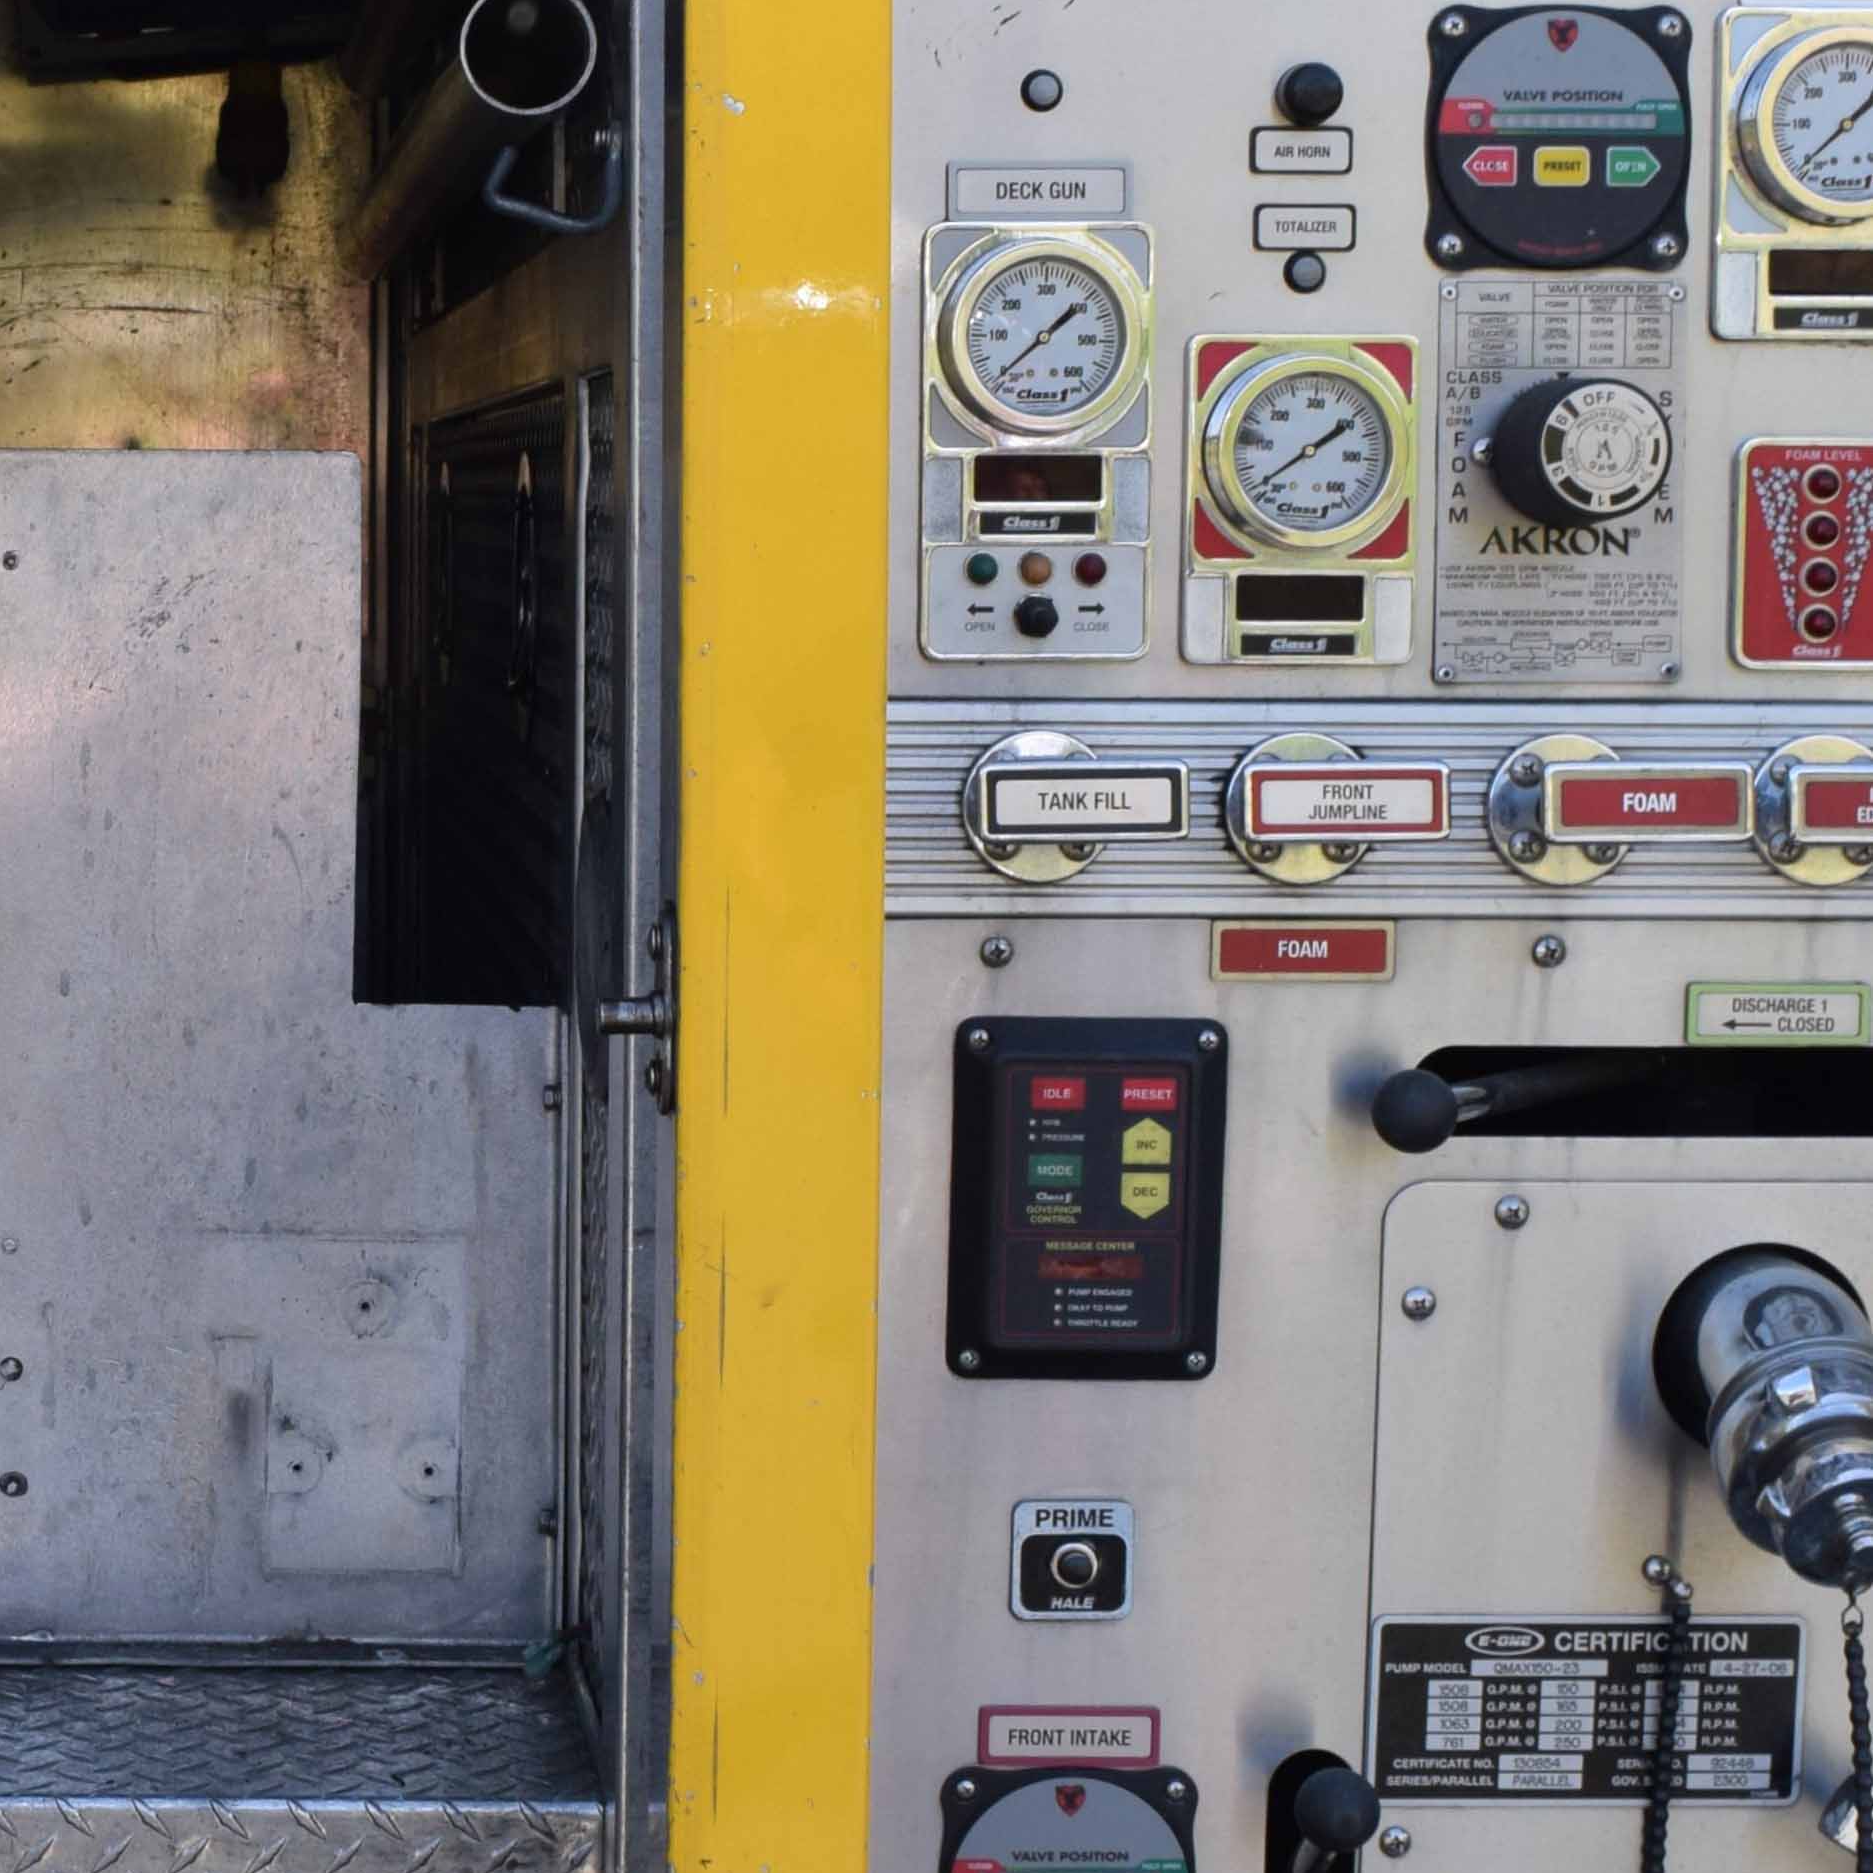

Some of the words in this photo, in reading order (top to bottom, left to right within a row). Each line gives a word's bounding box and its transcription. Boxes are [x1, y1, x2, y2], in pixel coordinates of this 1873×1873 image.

[1838, 71, 1856, 82] 300
[1504, 90, 1546, 101] VALVE
[1552, 90, 1623, 101] POSITION
[1804, 87, 1822, 98] 200
[1793, 119, 1811, 129] 100
[1275, 146, 1294, 158] AIR
[1297, 146, 1331, 158] HORN
[1473, 161, 1509, 172] CLOSE
[1543, 161, 1582, 171] PRESET
[1615, 161, 1647, 172] OPEN
[996, 182, 1042, 199] DECK
[1049, 182, 1086, 199] GUN
[1275, 221, 1337, 233] TOTALIZER
[1037, 284, 1055, 295] 300
[1547, 285, 1579, 293] VALVE
[1583, 285, 1633, 294] POSITION
[1478, 293, 1510, 302] VALVE
[1002, 300, 1021, 311] 200
[989, 330, 1008, 340] 100
[1078, 335, 1097, 346] 500
[1064, 366, 1083, 377] 600
[1446, 371, 1502, 384] CLASS
[1446, 387, 1481, 401] A/B
[1583, 391, 1615, 406] OFF
[1306, 398, 1325, 410] 300
[1270, 410, 1289, 422] 200
[1342, 450, 1361, 462] 500
[1785, 449, 1821, 461] FOAM
[1824, 449, 1862, 462] LEVEL
[1326, 482, 1345, 493] 600
[1479, 527, 1630, 555] AKRON
[965, 622, 995, 631] OPEN
[1074, 622, 1109, 631] CLOSE
[1322, 784, 1374, 800] FRONT
[1038, 792, 1087, 811] TANK
[1094, 792, 1131, 811] FILL
[1622, 792, 1677, 813] FOAM
[1307, 804, 1388, 821] JUMPLINE
[1277, 940, 1328, 959] FOAM
[1732, 998, 1817, 1013] DISCHARGE
[1821, 998, 1828, 1013] 1
[1777, 1017, 1835, 1032] CLOSED
[1043, 1088, 1071, 1099] IDLE
[1124, 1088, 1173, 1100] PRESET
[1136, 1140, 1158, 1150] INC
[1037, 1165, 1073, 1176] MODE
[1133, 1186, 1158, 1197] DEC
[1026, 1206, 1082, 1214] GOVERNOR
[1030, 1215, 1078, 1224] CONTROL
[1046, 1241, 1092, 1251] MESSAGE
[1096, 1241, 1135, 1251] CENTER
[1035, 1509, 1114, 1527] PRIME
[1050, 1597, 1095, 1610] HALE
[1478, 1635, 1532, 1646] E-ONE
[1554, 1631, 1748, 1652] CERTIFICTION
[1385, 1663, 1421, 1673] PUMP
[1424, 1663, 1466, 1673] MODEL
[1008, 1729, 1065, 1746] FRONT
[1070, 1729, 1132, 1746] INTAKE
[1393, 1758, 1470, 1769] CERTIFICATE
[1474, 1758, 1494, 1769] NO.
[1386, 1775, 1493, 1786] SERIES/PARALLEL
[1512, 1775, 1572, 1786] PARALLEL
[1612, 1776, 1640, 1786] GOV.
[1011, 1851, 1054, 1862] VALVE
[1060, 1851, 1129, 1861] POSITION
